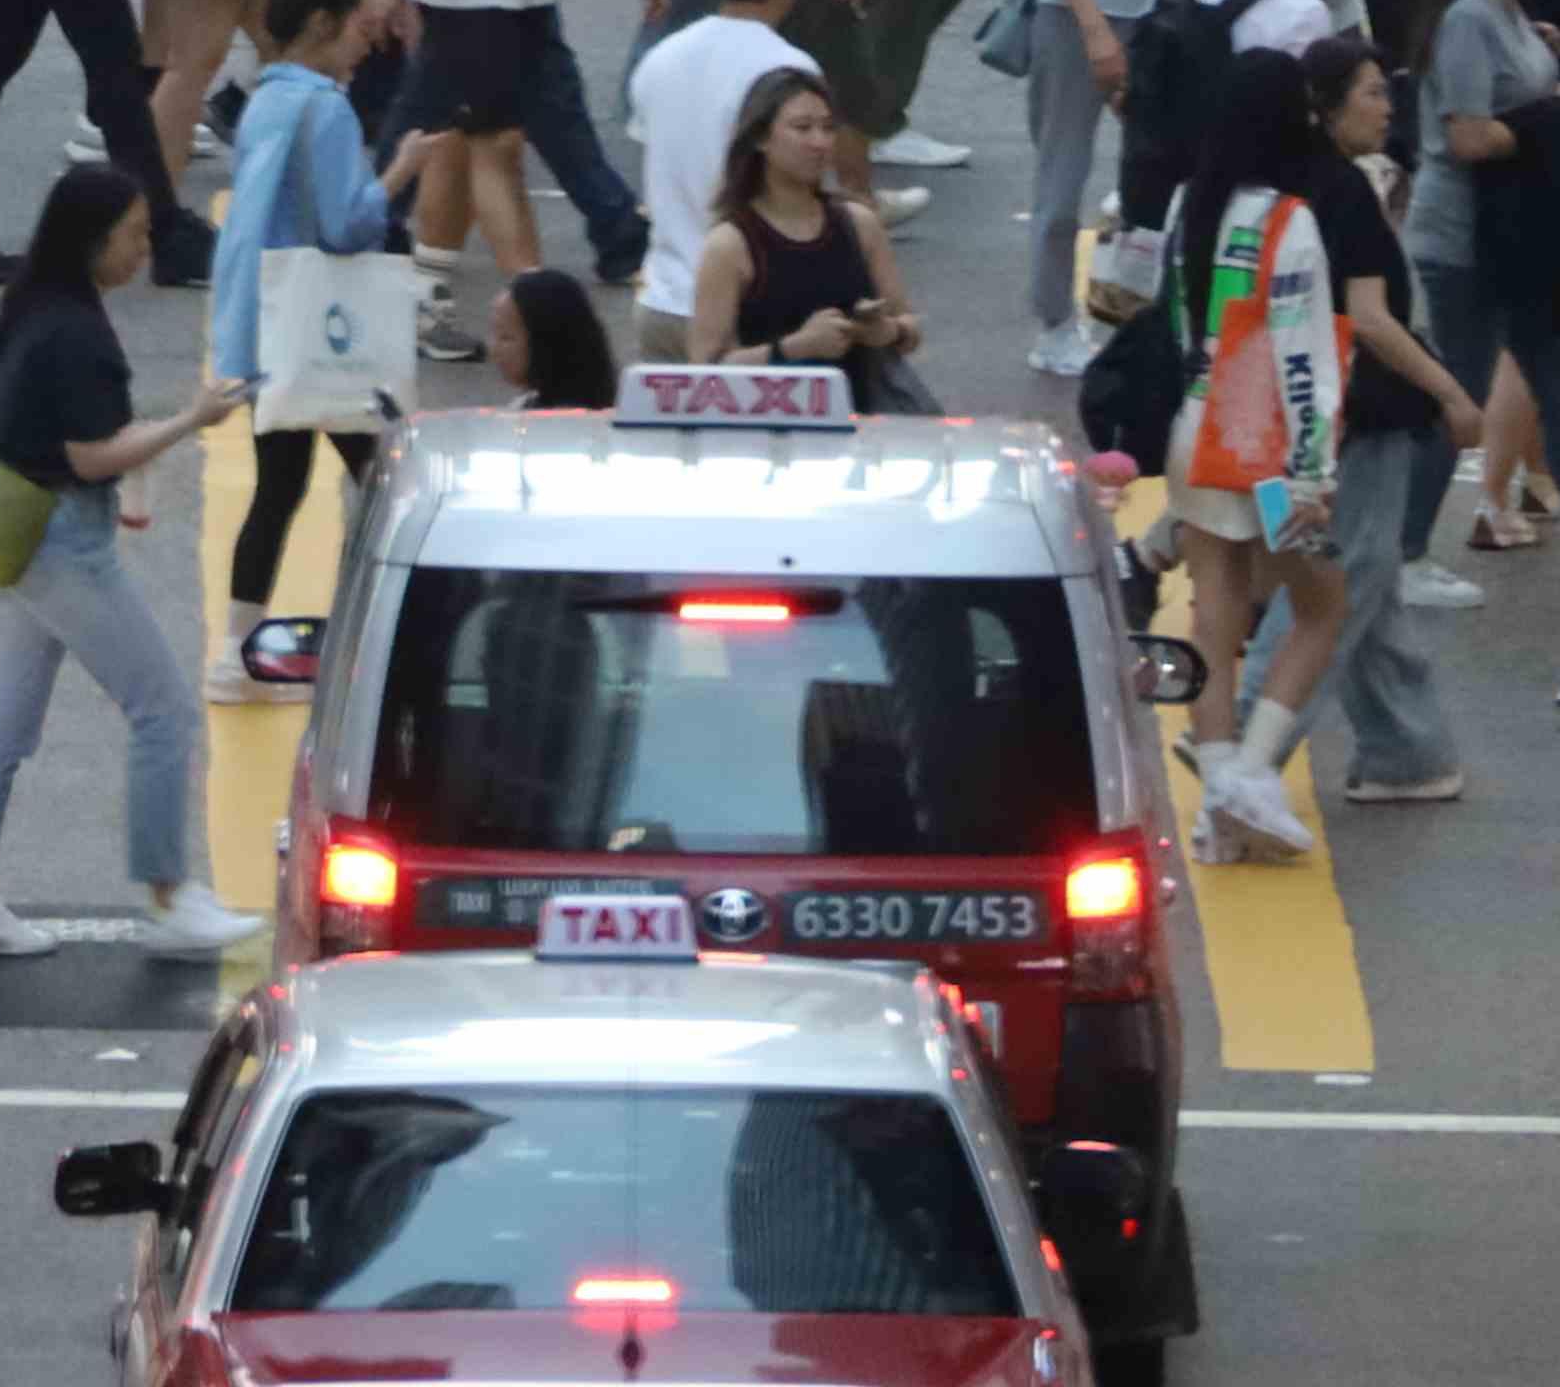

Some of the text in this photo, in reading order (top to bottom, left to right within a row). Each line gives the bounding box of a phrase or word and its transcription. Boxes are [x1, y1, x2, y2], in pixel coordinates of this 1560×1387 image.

[642, 374, 831, 417] TAXI
[559, 907, 681, 943] TAXI
[792, 896, 1037, 938] 6330 7453
